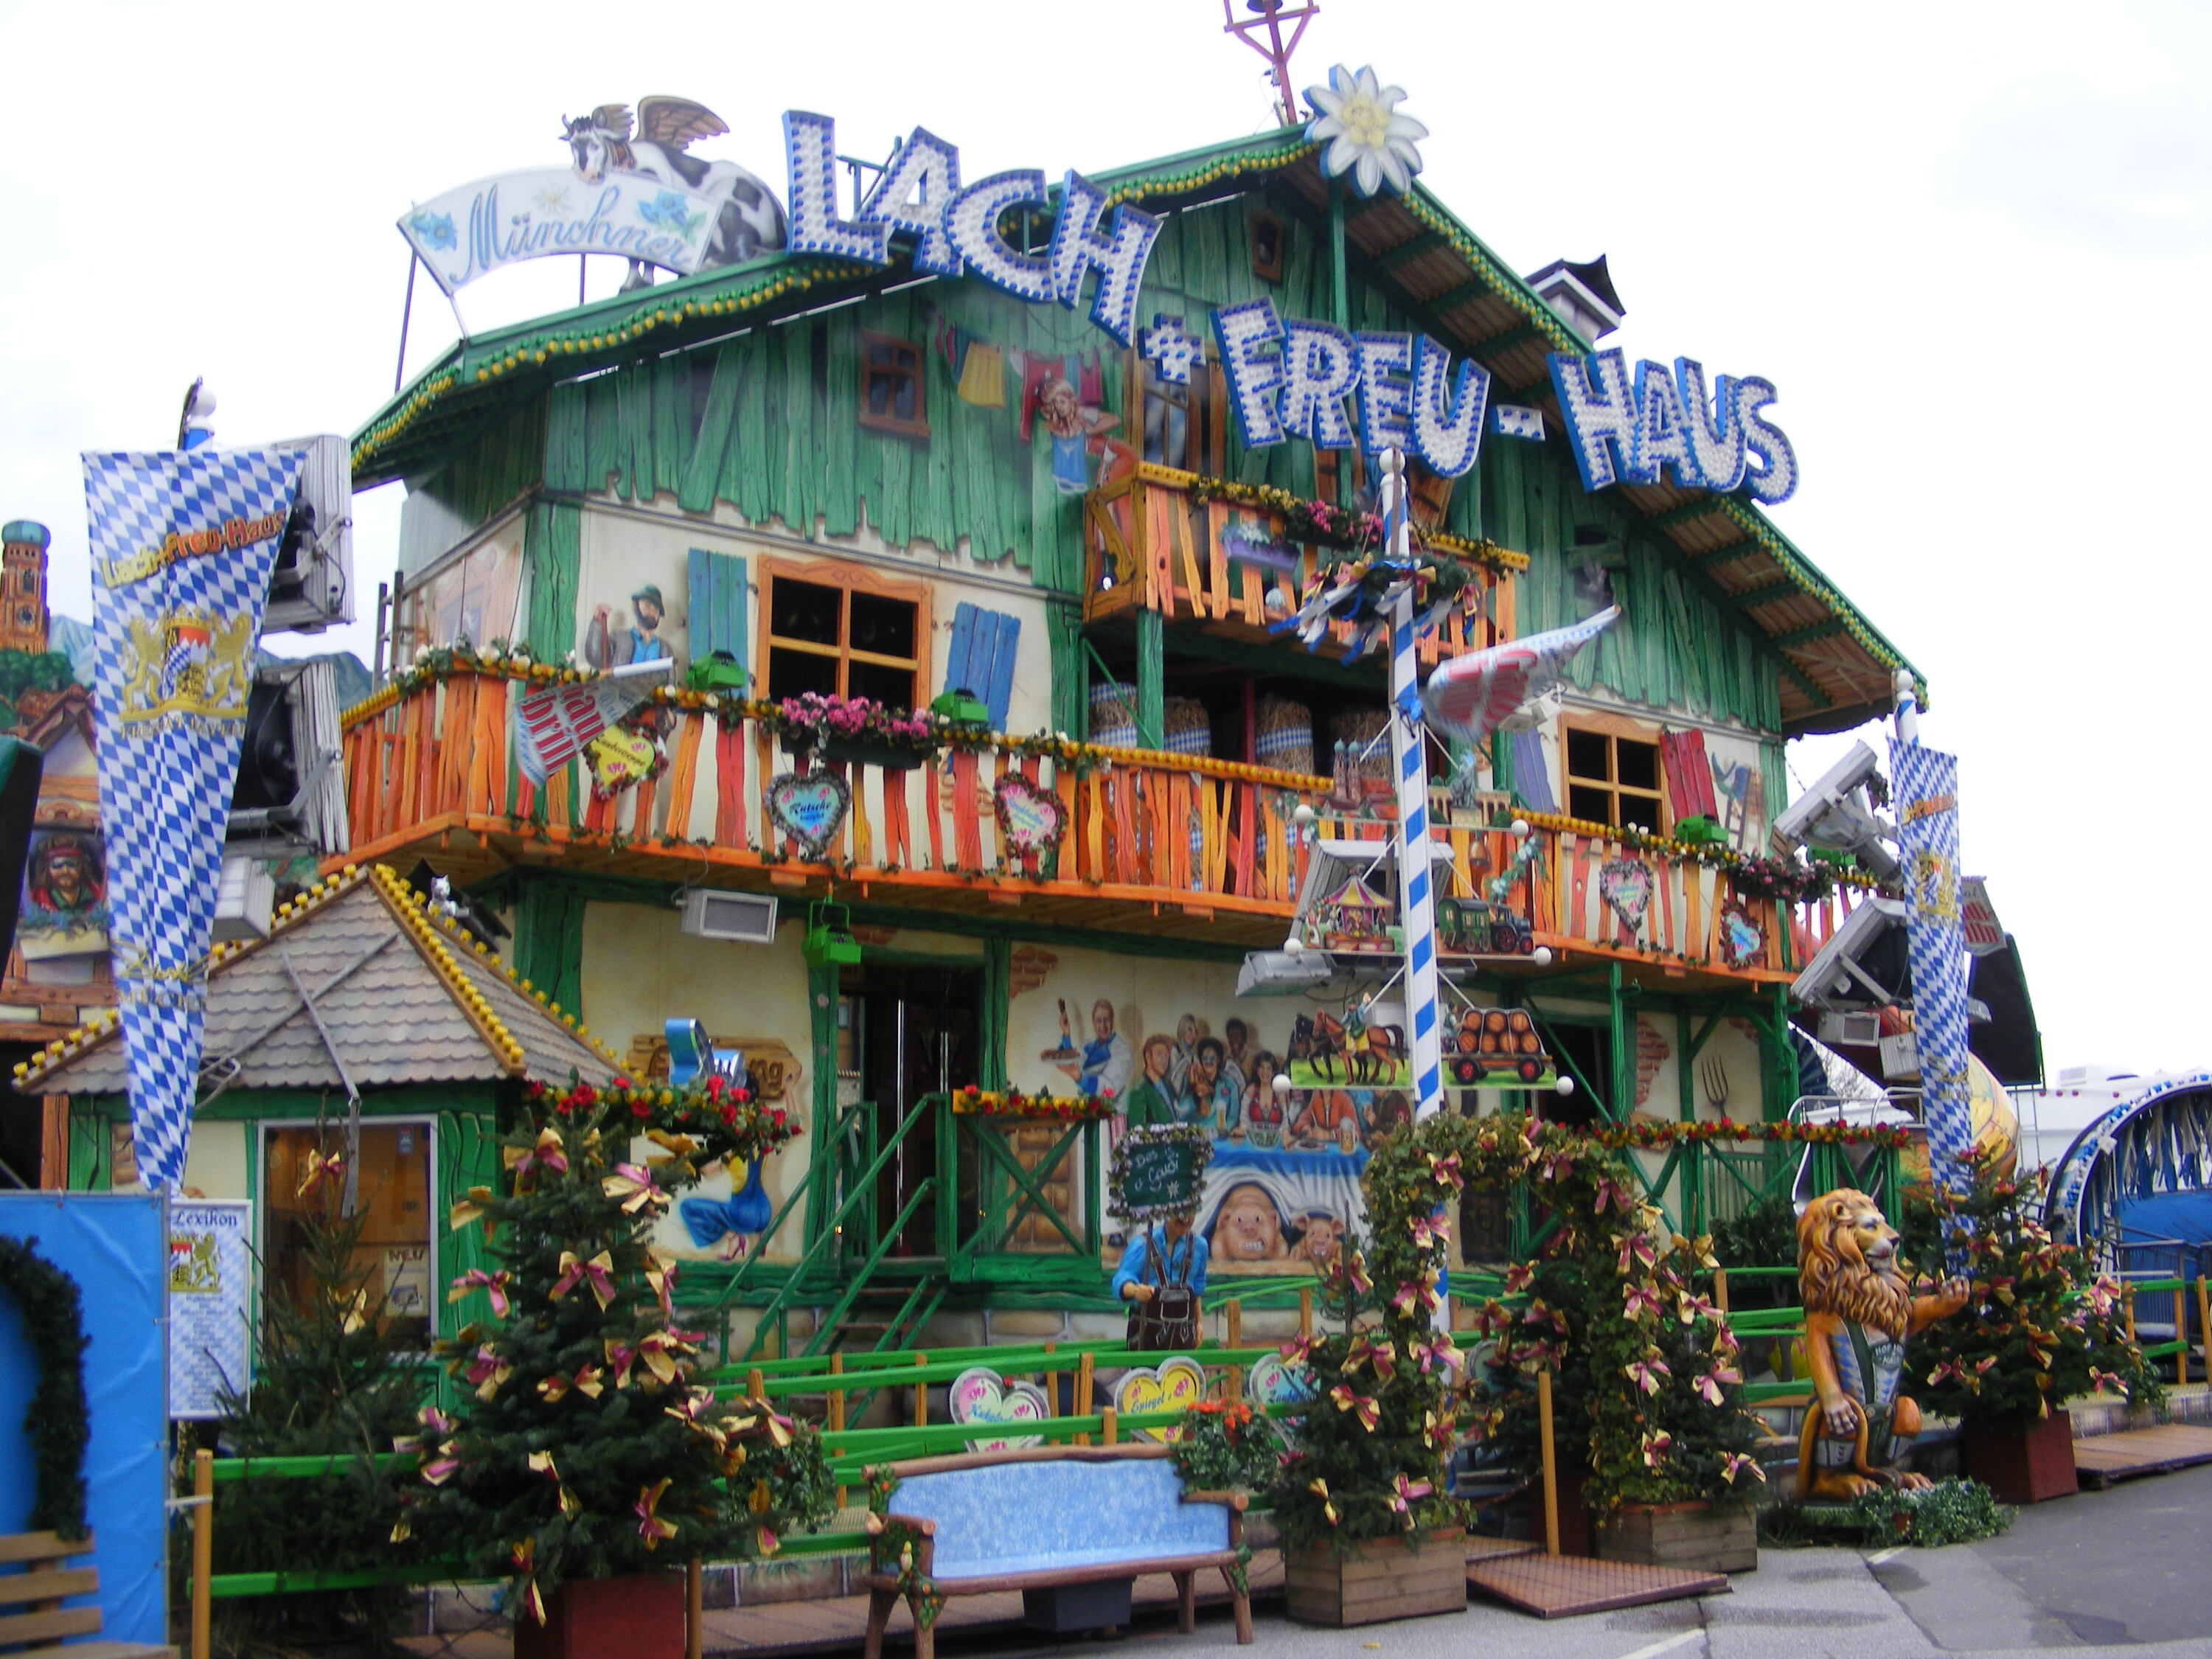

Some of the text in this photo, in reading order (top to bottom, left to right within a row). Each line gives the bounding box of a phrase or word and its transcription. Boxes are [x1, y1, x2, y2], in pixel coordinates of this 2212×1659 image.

[449, 184, 692, 284] Münchner
[782, 109, 1163, 349] LACH
[174, 1209, 237, 1227] Lexikon
